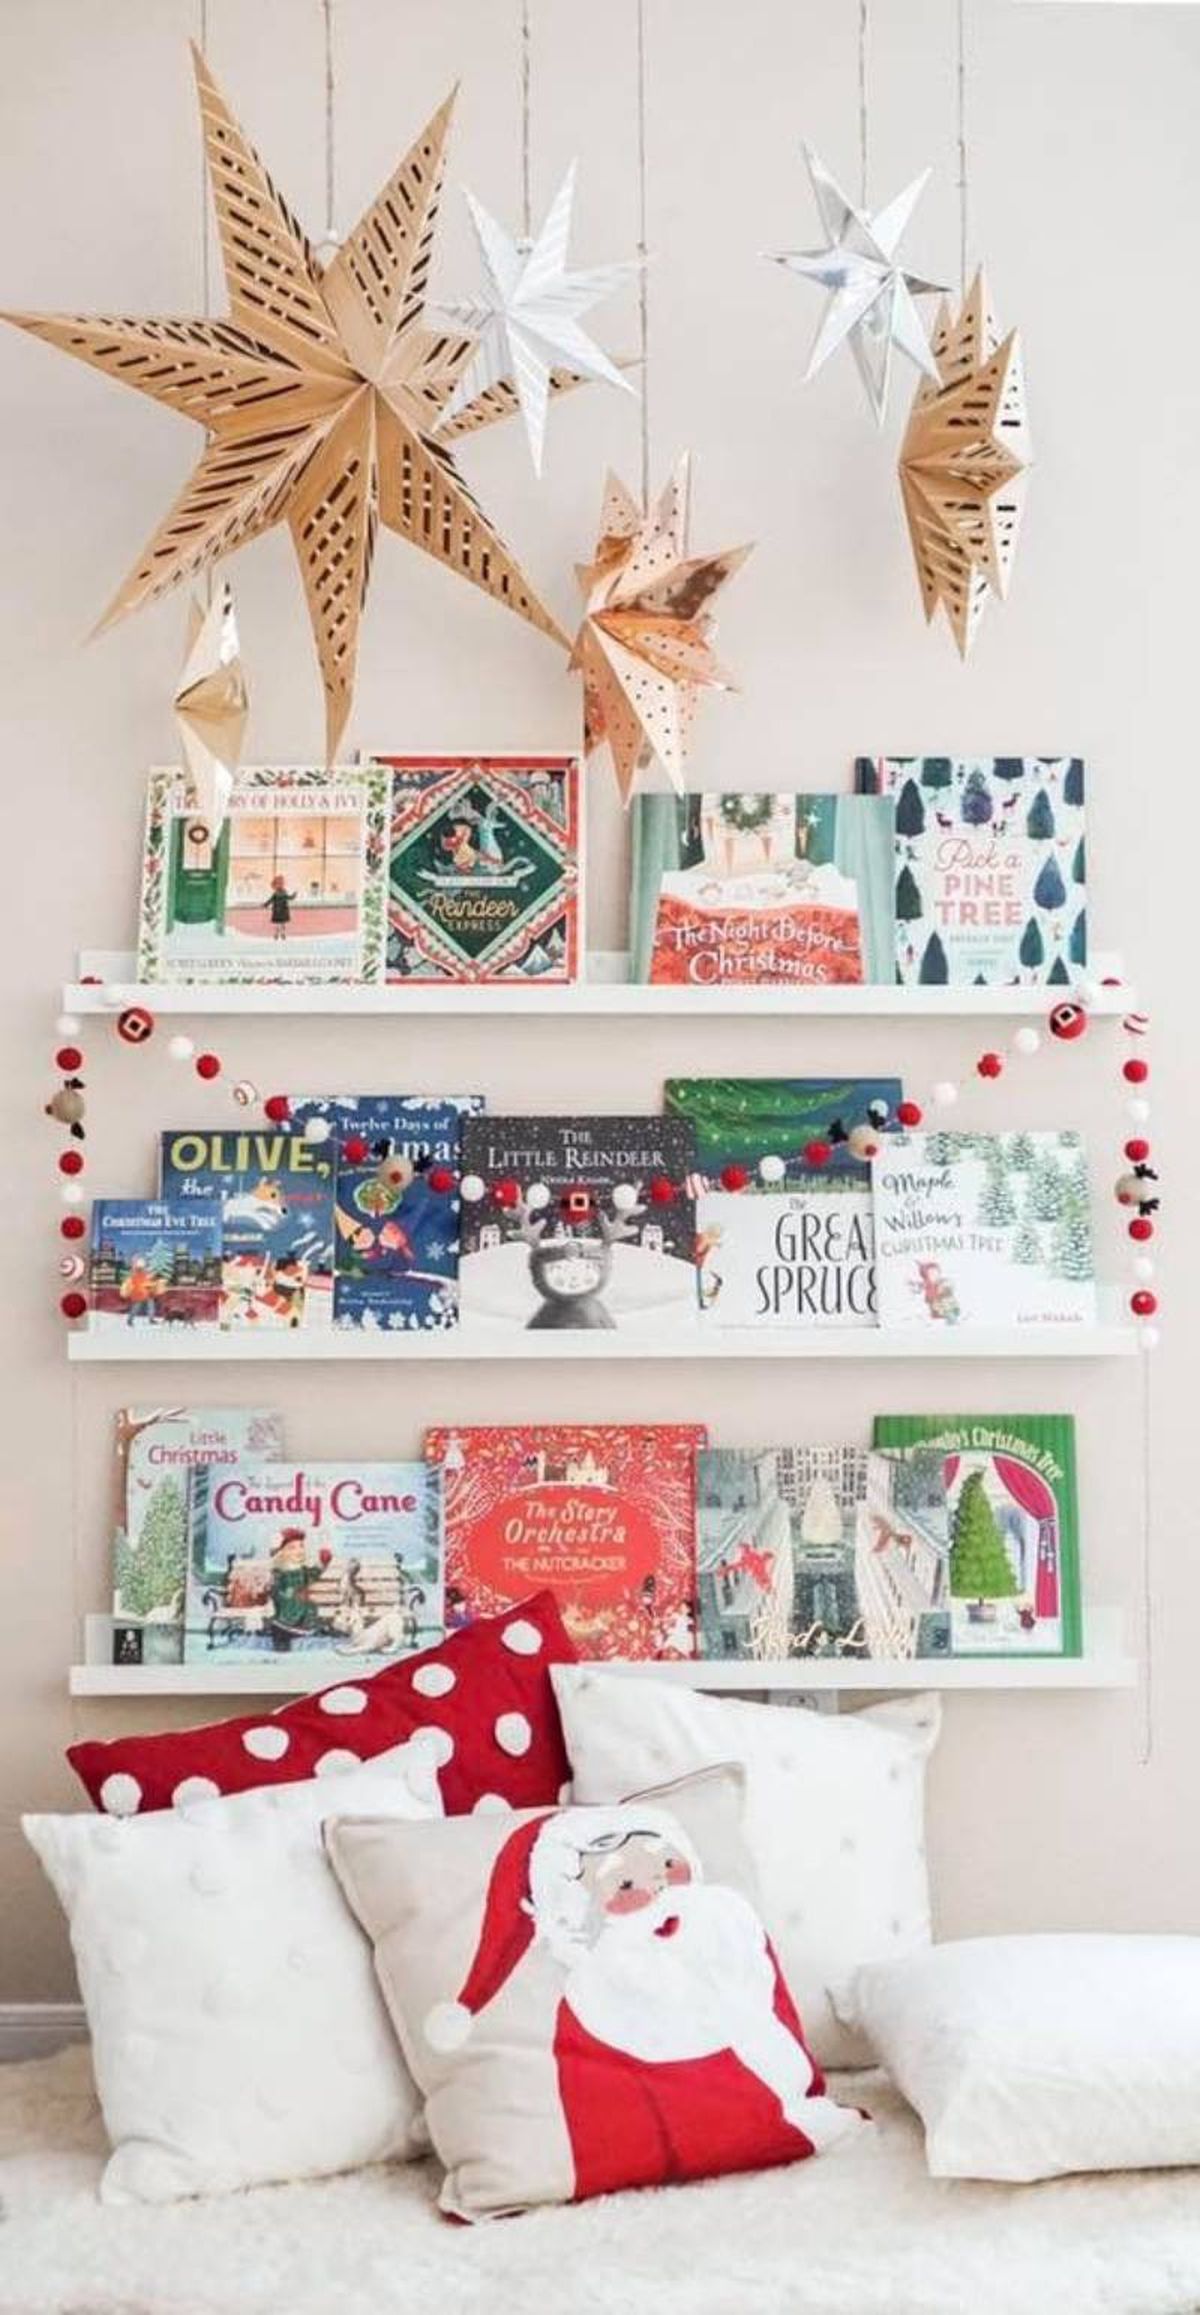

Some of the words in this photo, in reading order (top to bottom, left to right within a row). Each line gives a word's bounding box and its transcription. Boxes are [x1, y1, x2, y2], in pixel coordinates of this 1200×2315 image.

[335, 795, 358, 808] IVY
[934, 838, 999, 872] Pick
[1005, 855, 1022, 869] a
[944, 874, 1014, 897] PINE
[430, 892, 520, 918] Reindeer
[934, 902, 1023, 925] TREE
[672, 918, 709, 950] The
[710, 915, 769, 951] Night
[770, 915, 857, 957] Before
[689, 946, 828, 984] Christmas
[340, 1117, 391, 1131] Twelve
[393, 1117, 431, 1135] Days
[433, 1117, 450, 1131] of
[558, 1128, 593, 1145] THE
[170, 1135, 331, 1179] OLIVE,
[488, 1147, 557, 1168] LITTLE
[565, 1147, 665, 1168] REINDEER
[180, 1177, 214, 1197] the
[882, 1169, 955, 1199] Maple
[756, 1265, 878, 1314] SPRUCE
[190, 1429, 227, 1445] Little
[148, 1445, 239, 1465] Christmas
[971, 1427, 1040, 1464] Christmas
[1037, 1450, 1064, 1480] Tree
[214, 1471, 321, 1527] Candy
[330, 1480, 417, 1522] Cane
[526, 1500, 558, 1520] The
[561, 1497, 618, 1525] Story
[505, 1517, 627, 1545] Orchestra
[502, 1557, 530, 1572] THE
[531, 1556, 627, 1572] NUTCRACKER
